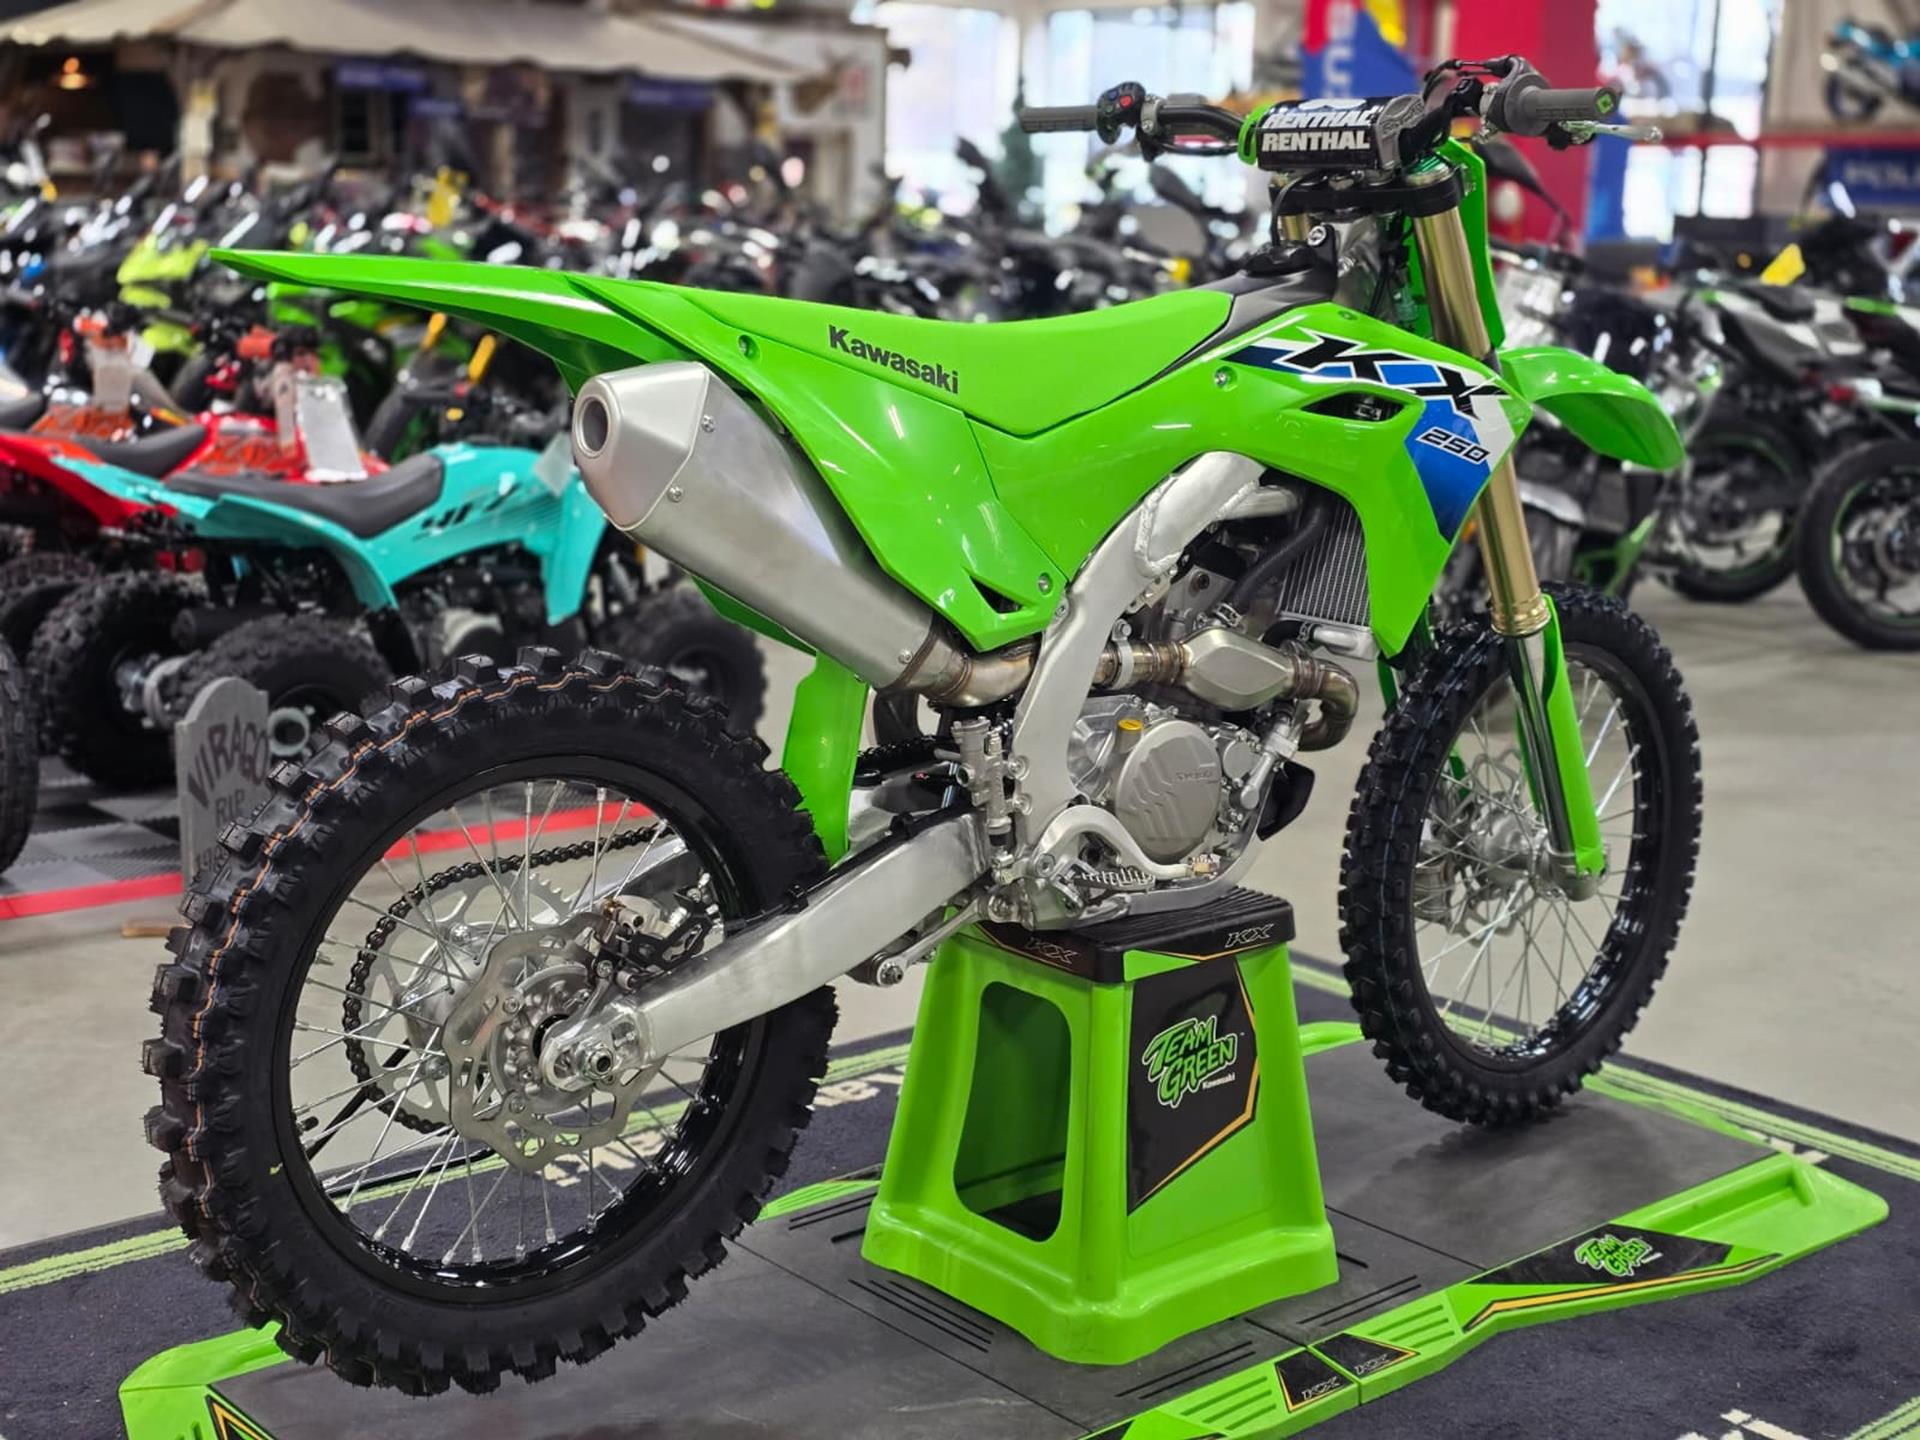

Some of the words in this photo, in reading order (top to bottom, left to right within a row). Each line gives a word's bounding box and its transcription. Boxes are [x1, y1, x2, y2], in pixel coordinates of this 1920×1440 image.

[1262, 109, 1373, 129] RENTHAL
[1262, 130, 1371, 152] RENTHAL
[828, 324, 959, 395] Kawasaki
[1273, 327, 1512, 420] KX
[1416, 426, 1490, 464] 250
[187, 714, 270, 810] VIRAGO
[215, 788, 247, 828] RIP
[1025, 936, 1079, 965] KX
[1224, 923, 1275, 948] KX
[1142, 1015, 1217, 1082] TEAM
[1158, 1034, 1238, 1109] GREEN
[1575, 1234, 1622, 1269] TEAM
[1602, 1238, 1653, 1277] GREEN
